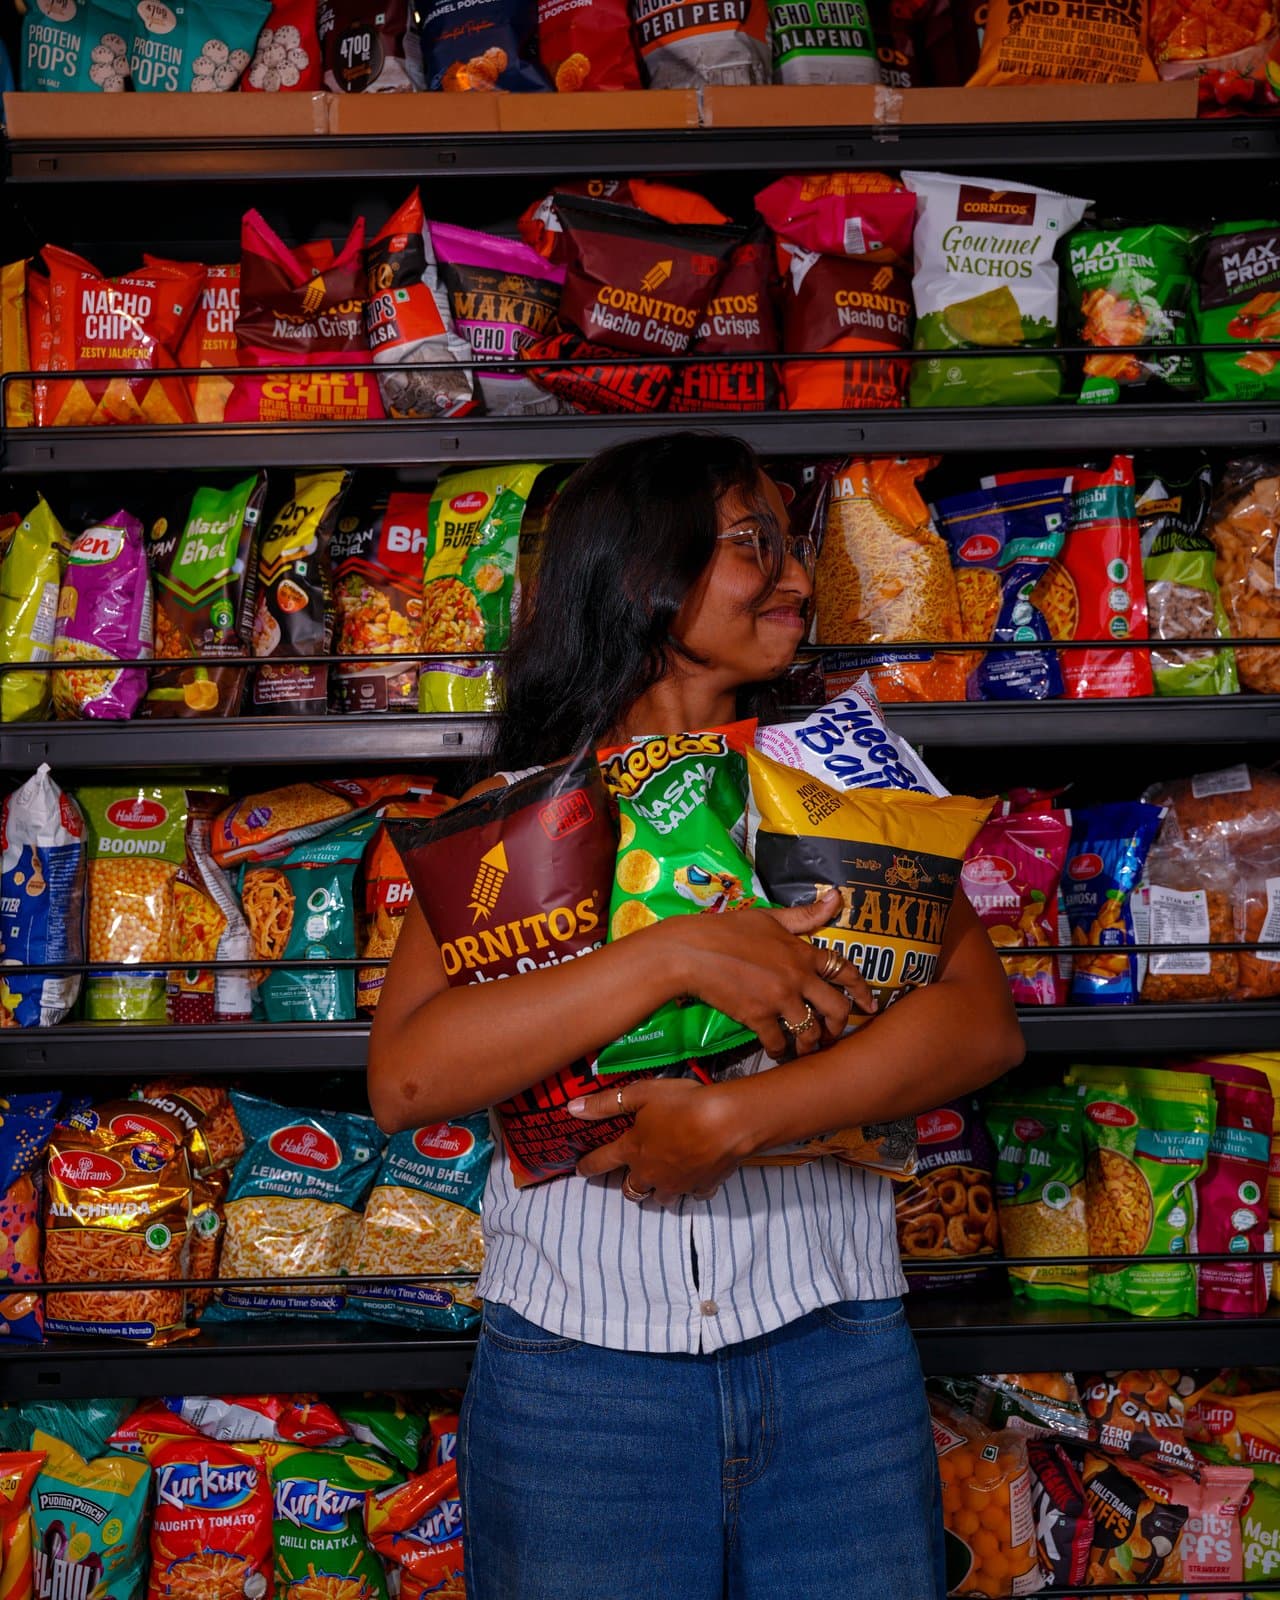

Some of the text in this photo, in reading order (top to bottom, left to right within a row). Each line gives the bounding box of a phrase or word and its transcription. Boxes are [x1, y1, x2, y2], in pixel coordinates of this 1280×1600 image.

[643, 1, 746, 42] PERI PERI
[817, 2, 866, 27] CHIPS
[1007, 0, 1059, 25] AND
[29, 24, 81, 52] PROTEIN
[133, 37, 182, 64] PROTEIN
[340, 33, 371, 60] 4700
[27, 42, 78, 78] POPS
[130, 59, 180, 92] POPS
[963, 202, 1028, 215] CORNITOS
[942, 225, 1042, 260] Gourmet
[1071, 237, 1124, 263] MAX
[1222, 238, 1278, 271] MAX
[207, 268, 227, 278] EX
[946, 256, 1033, 279] NACHOS
[1071, 252, 1157, 280] PROTEIN
[1224, 255, 1280, 287] PROT
[120, 278, 157, 289] MEX
[82, 290, 151, 317] NACHO
[202, 287, 241, 311] NAC
[596, 285, 698, 331] CORNITOS
[706, 292, 758, 318] ITOS
[834, 289, 911, 316] CORNIT
[85, 316, 146, 345] CHIPS
[590, 305, 690, 353] Nacho Crisps
[712, 316, 761, 345] Crisps
[836, 305, 885, 331] Nacho
[202, 339, 228, 351] ZESTY
[369, 321, 398, 350] ALSA
[81, 347, 107, 359] ZESTY
[261, 382, 369, 406] CHILI
[842, 384, 893, 400] MAS
[281, 502, 315, 521] Dry
[330, 529, 374, 549] ALYAN
[387, 526, 428, 554] Bh
[444, 521, 482, 537] BHEL
[180, 536, 228, 565] Bhel
[331, 543, 364, 558] BHEL
[218, 613, 229, 626] 3
[796, 783, 819, 800] NOW
[801, 791, 833, 814] EXTRA
[542, 796, 587, 825] GLUTEN
[557, 808, 589, 833] FREE
[98, 837, 167, 855] BOONDI
[385, 880, 414, 904] BH
[970, 894, 1021, 909] ATHRI
[440, 897, 600, 977] ORNITOS
[627, 1030, 665, 1047] NAMKEEN
[1152, 1131, 1204, 1146] Navratan
[1166, 1144, 1185, 1158] Mix
[388, 1152, 473, 1185] LEMON BHEL
[1029, 1147, 1052, 1168] DAL
[250, 1164, 343, 1193] LEMON BHEL
[252, 1295, 269, 1306] Lite
[270, 1296, 287, 1309] Any
[287, 1297, 308, 1308] Time
[1119, 1401, 1184, 1429] GARLI
[1099, 1435, 1132, 1453] MAIDA
[1101, 1424, 1133, 1443] ZERO
[261, 1442, 278, 1457] 20
[1158, 1439, 1196, 1464] 100%
[155, 1460, 258, 1512] Kurkure
[274, 1478, 363, 1529] Kurkur
[1089, 1479, 1138, 1519] MILLETBANK
[209, 1513, 255, 1527] TOMATO
[279, 1534, 358, 1551] CHILLI CHATKA
[400, 1540, 454, 1566] MASALA
[1180, 1532, 1233, 1563] ffs
[1188, 1565, 1231, 1574] STRAWBERRY
